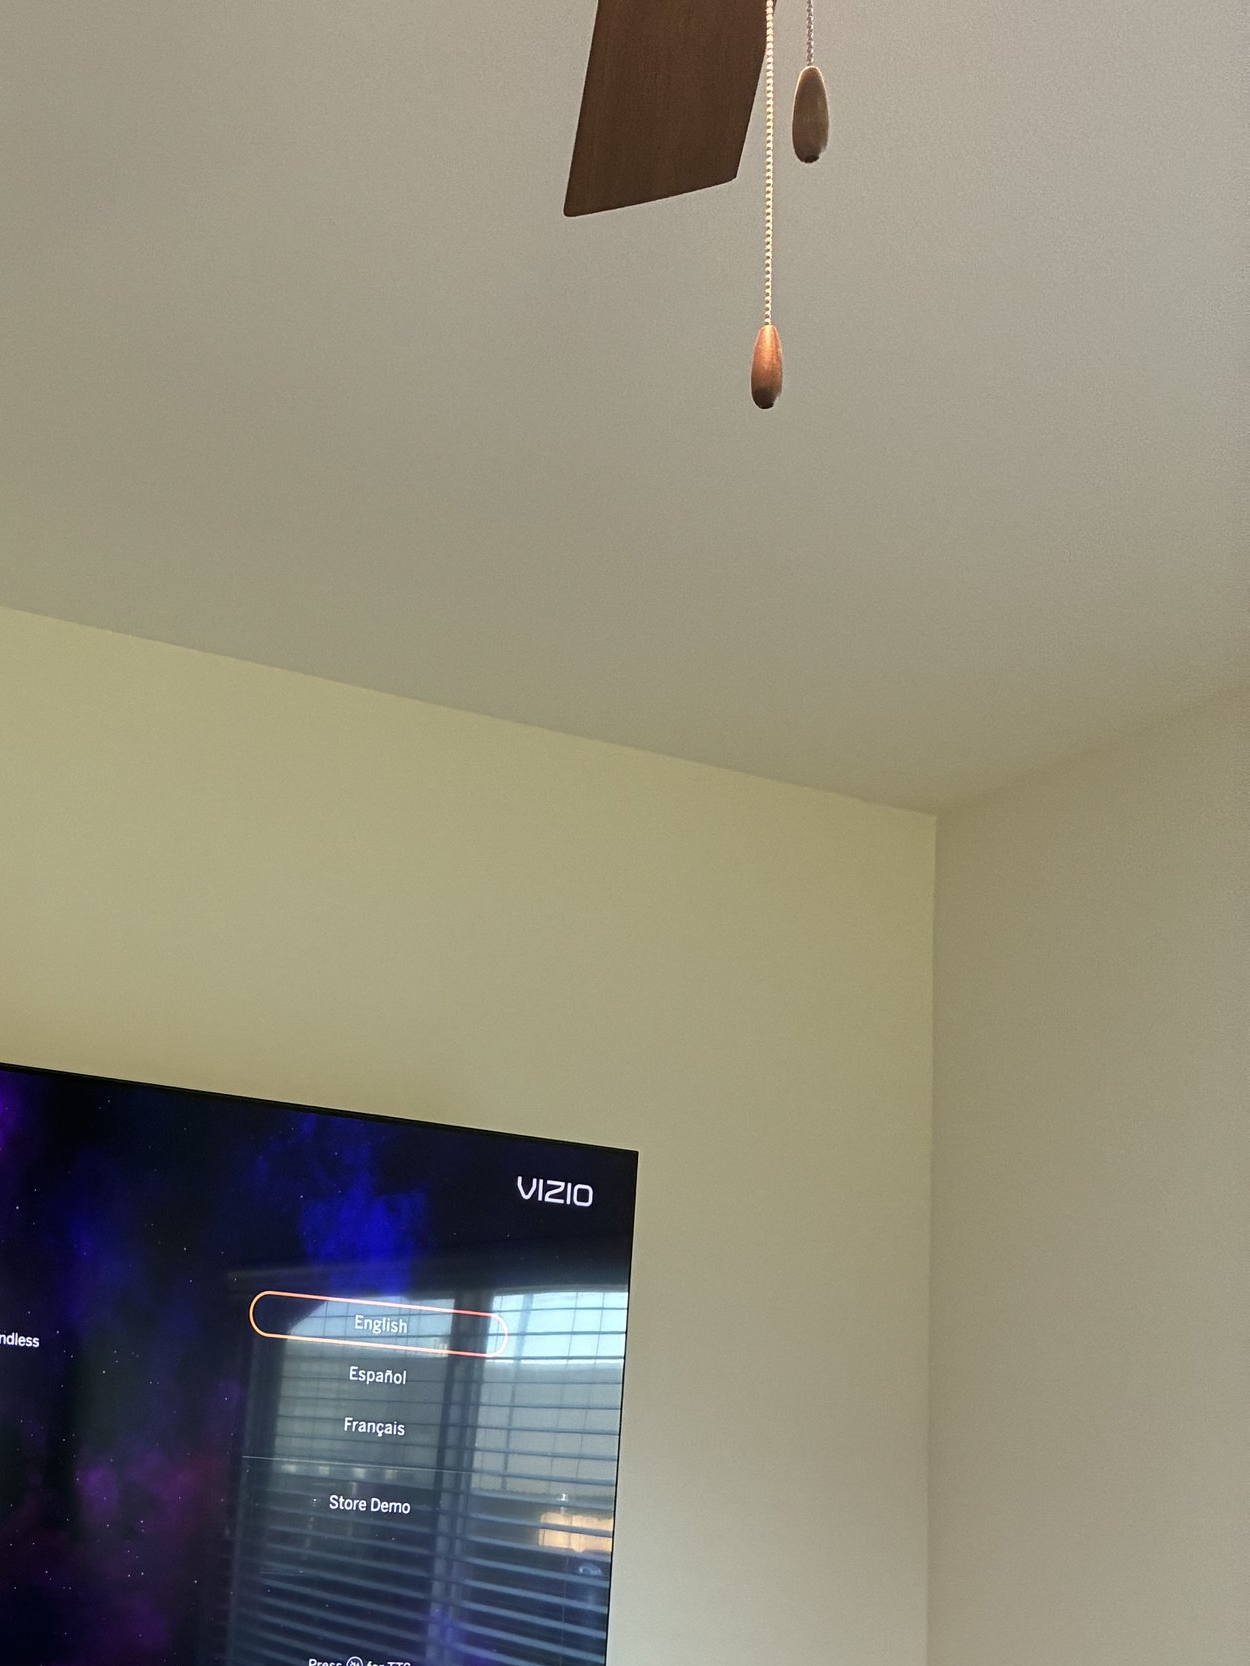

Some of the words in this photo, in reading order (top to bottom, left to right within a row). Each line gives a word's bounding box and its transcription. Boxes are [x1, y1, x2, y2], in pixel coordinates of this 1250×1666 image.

[517, 1175, 594, 1207] VIZIO
[354, 1314, 408, 1335] English
[349, 1365, 407, 1385] Español
[343, 1416, 406, 1437] Français
[329, 1494, 367, 1512] Store
[370, 1497, 411, 1514] Demo
